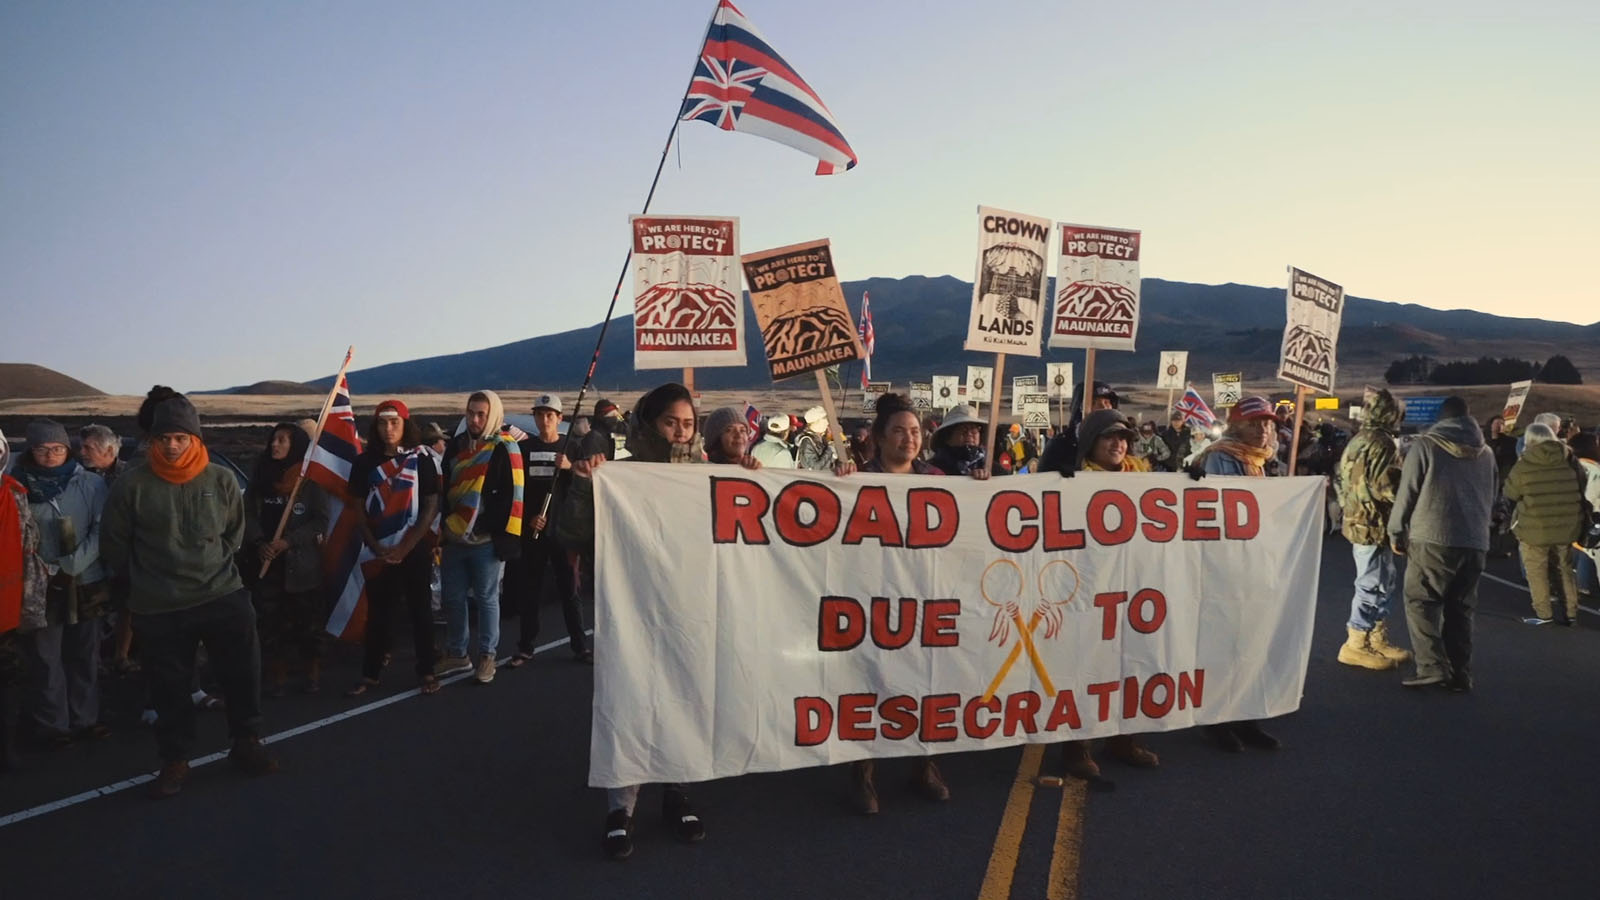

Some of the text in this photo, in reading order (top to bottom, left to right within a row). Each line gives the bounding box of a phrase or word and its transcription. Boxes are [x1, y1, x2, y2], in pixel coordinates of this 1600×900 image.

[648, 224, 720, 236] WE ARE HERE TO
[983, 215, 1049, 243] CROWN
[1086, 232, 1100, 240] ARE
[1101, 233, 1118, 242] HERE
[1119, 237, 1129, 245] TO
[641, 234, 727, 252] PROTECT
[1068, 240, 1134, 258] PROTECT
[757, 254, 820, 273] WE ARE HERE TO
[753, 262, 827, 290] PROTECT
[1294, 282, 1338, 310] PROTECT
[977, 314, 1034, 336] LANDS
[1057, 320, 1130, 334] MAUNAKEA
[640, 332, 733, 346] MAUNAKEA
[772, 346, 854, 376] MAUNAKEA
[1284, 361, 1330, 386] MAUNAKEA
[709, 475, 1260, 553] ROAD CLOSED
[817, 587, 1168, 652] DUE TO
[794, 668, 1205, 747] DESECRATION
